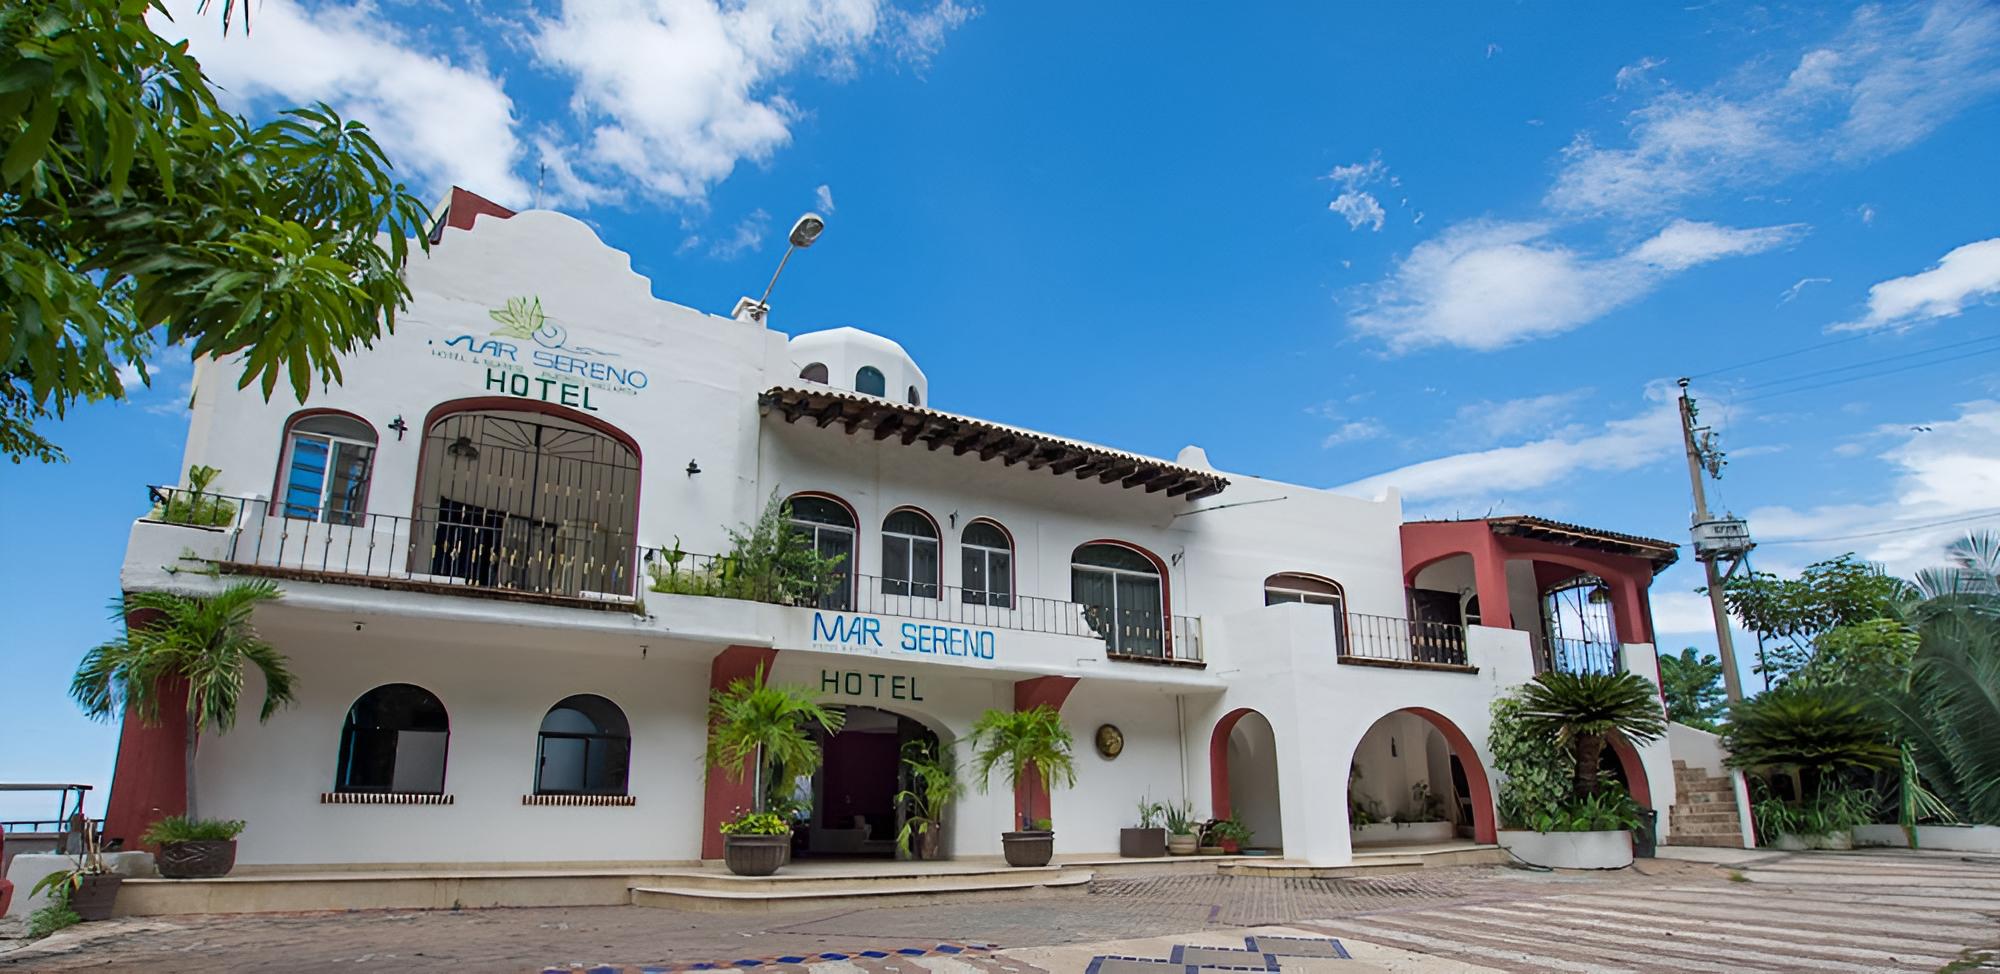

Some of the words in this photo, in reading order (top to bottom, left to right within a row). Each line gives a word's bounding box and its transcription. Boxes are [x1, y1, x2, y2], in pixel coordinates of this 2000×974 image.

[445, 335, 517, 361] MAR
[533, 350, 648, 389] SERENO
[486, 368, 598, 411] HOTEL
[813, 612, 883, 647] MAR
[901, 622, 996, 660] SERENO
[821, 669, 924, 702] HOTEL
